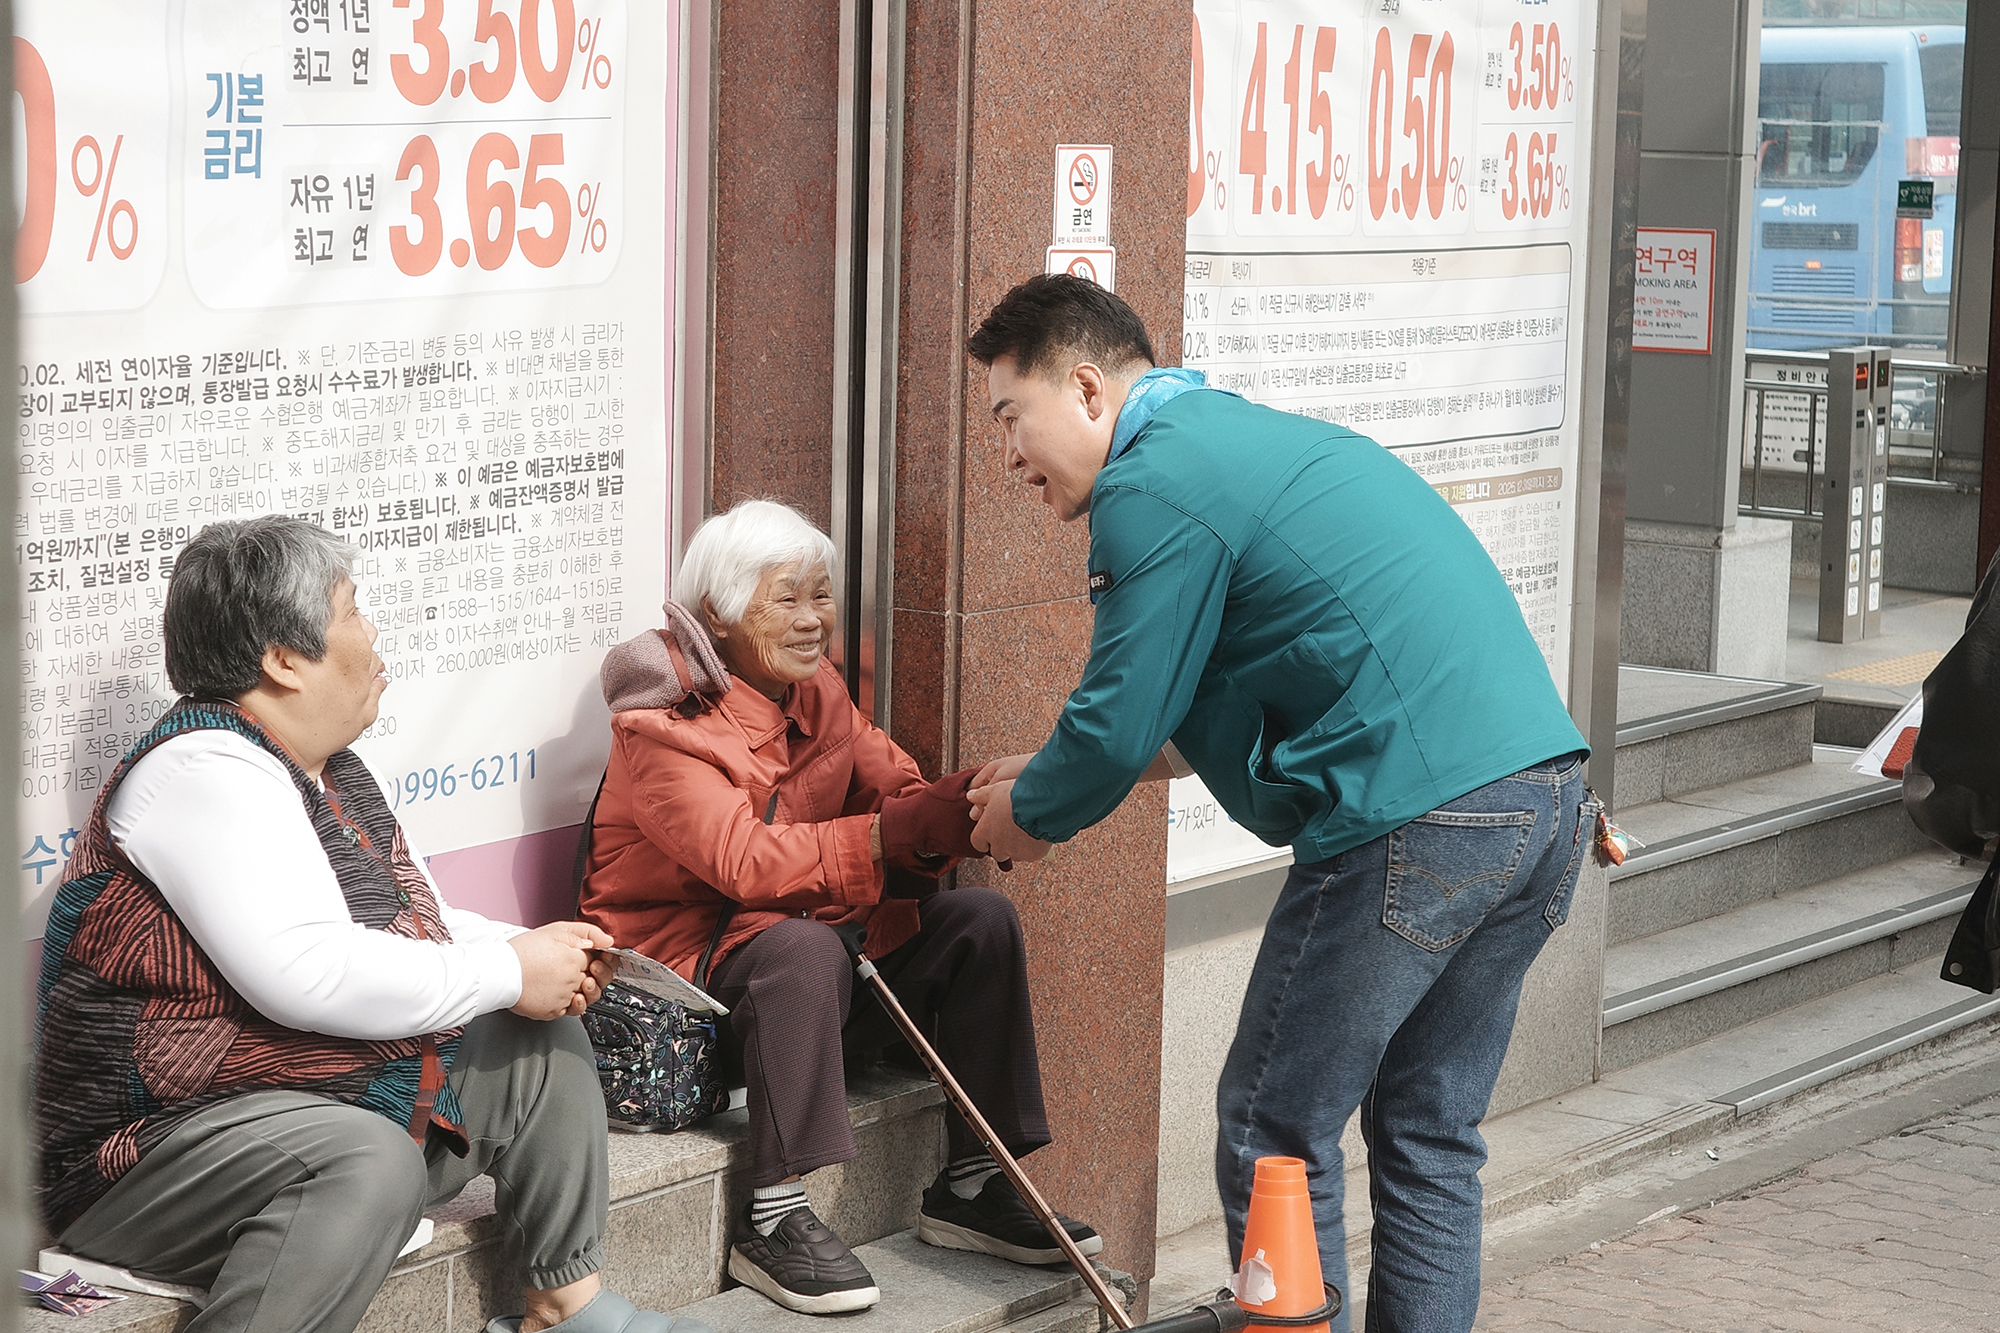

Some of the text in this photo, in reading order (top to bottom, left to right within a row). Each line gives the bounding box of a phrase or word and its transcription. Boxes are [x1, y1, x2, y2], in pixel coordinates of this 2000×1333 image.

[290, 0, 370, 33] 정액 1년
[293, 47, 369, 86] 최고 연
[390, 0, 612, 106] 3.50%
[1507, 21, 1573, 111] 3.50%
[206, 72, 264, 123] 기본
[1239, 22, 1354, 220] 4.15%
[1368, 26, 1467, 221] 0.50%
[204, 128, 262, 180] 금리
[1501, 131, 1570, 221] 3.65%
[290, 173, 374, 214] 자유 1년
[389, 132, 607, 277] 3.65%
[1073, 208, 1092, 226] 금연
[1798, 201, 1817, 217] brt
[294, 224, 369, 266] 최고 연
[1636, 246, 1697, 276] 연구역
[1673, 279, 1698, 289] AREA
[60, 387, 133, 414] 교부되지
[140, 383, 195, 410] 않으며,
[202, 378, 269, 404] 통장발급
[276, 373, 322, 397] 요청시
[328, 367, 398, 394] 수수료가
[403, 360, 477, 388] 발생합니다.
[506, 353, 544, 378] 비대면
[548, 349, 592, 372] 채널을
[597, 347, 624, 370] 통한
[76, 321, 624, 384] 세전 연이자율 기준입니다. 단, 기준금리 변동 등의 사유 발생 시 금리가
[18, 398, 624, 476] 요청 시 이자를 지급합니다. 중도해지금리 및 만기 후 금리는 당행이 고시한
[20, 373, 610, 447] 인명의의 입출금이 자유로운 수협은행 예금계좌가 필요합니다. 이자지급시기
[31, 424, 624, 503] 우대금리를 지급하지 않습니다. 비과세종합저축 요건 및 대상을 충족하는 경우
[39, 449, 624, 535] 법률 변경에 따른 우대혜택이 변경될 수 있습니다.) 이 예금은 예금자보호법에
[27, 568, 70, 593] 조치,
[80, 558, 150, 588] 질권설정
[359, 523, 438, 552] 이자지급이
[445, 512, 522, 542] 제한됩니다.
[551, 501, 603, 528] 계약체결
[610, 499, 623, 521] 전
[140, 525, 191, 553] 은행의
[332, 503, 368, 530] 합산)
[377, 494, 460, 523] 보호됩니다.
[489, 478, 589, 511] 예금잔액증명서
[597, 475, 624, 497] 발급
[46, 525, 623, 622] 상품설명서 및 금융소비자는 금융소비자보호법
[55, 550, 624, 649] 대하여 설명을 듣고 내용을 충분히 이해한 후
[47, 642, 161, 679] 자세한 내용은
[56, 683, 71, 708] 및
[408, 630, 437, 652] 예상
[446, 617, 517, 646] 이자수취액
[581, 601, 623, 624] 적립금
[590, 626, 619, 648] 세전
[23, 740, 76, 770] 대금리
